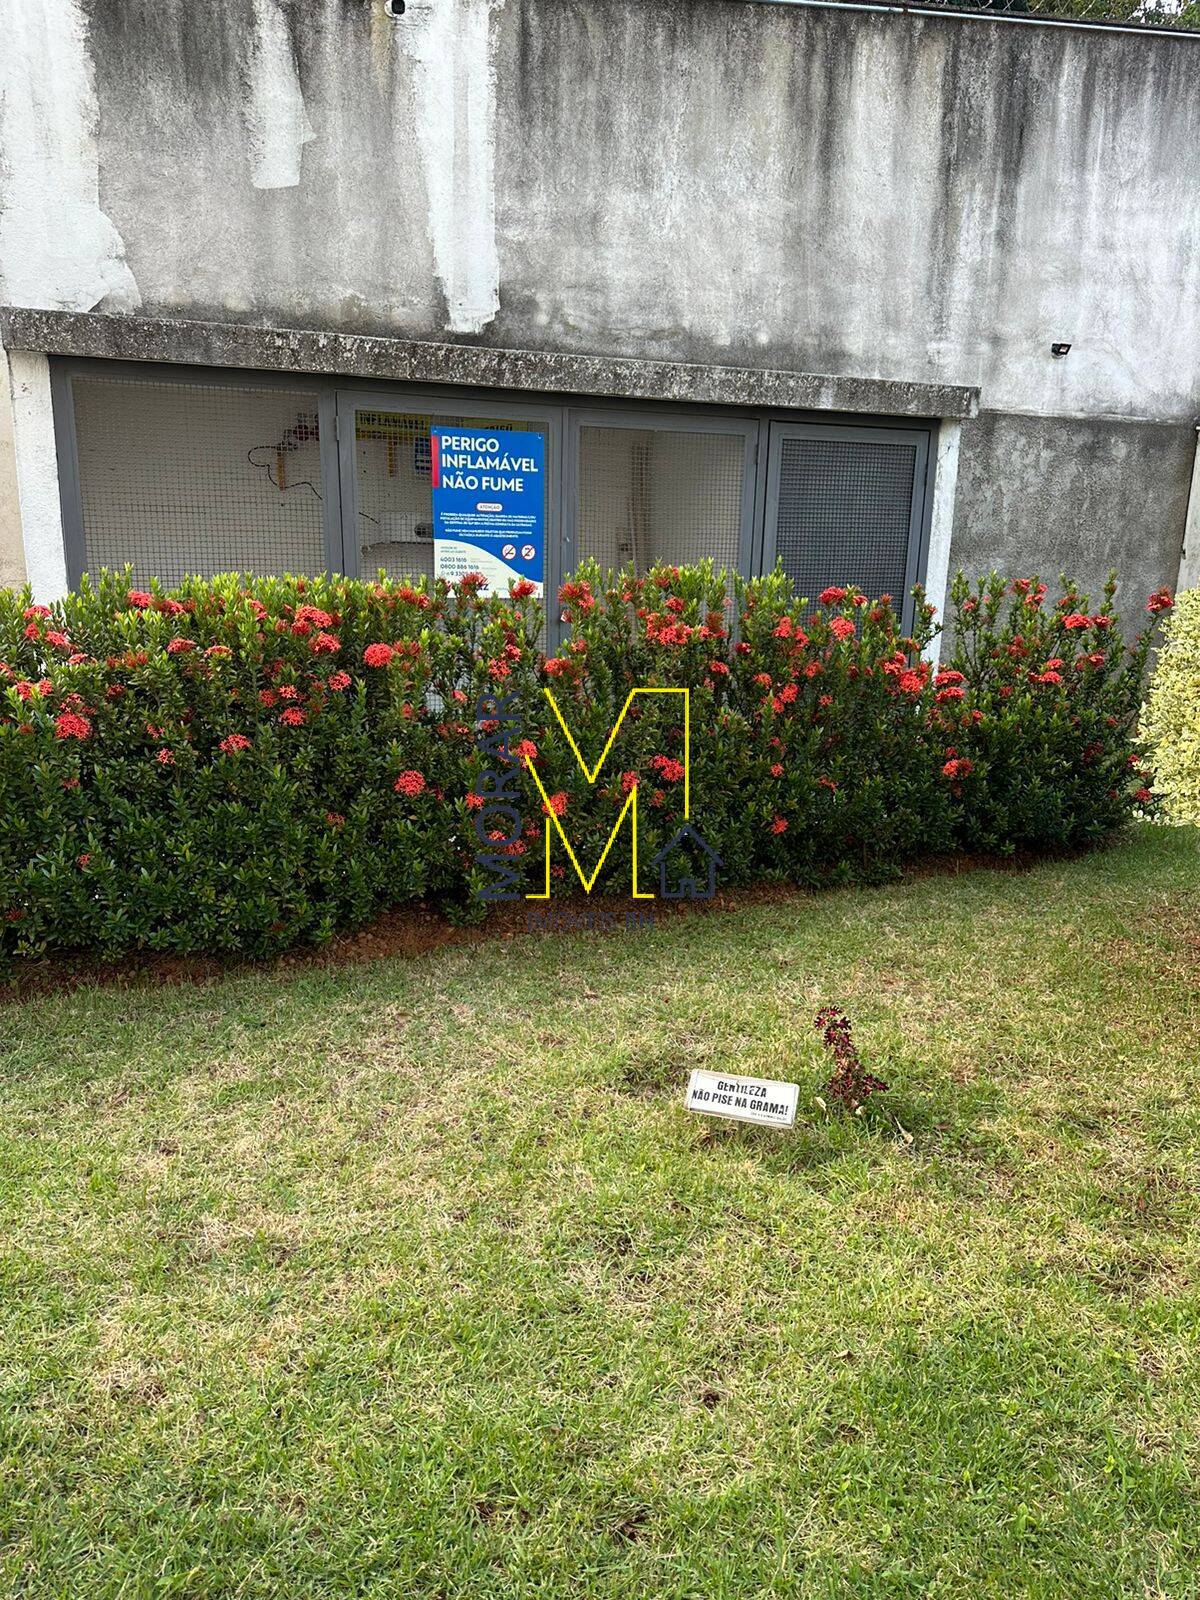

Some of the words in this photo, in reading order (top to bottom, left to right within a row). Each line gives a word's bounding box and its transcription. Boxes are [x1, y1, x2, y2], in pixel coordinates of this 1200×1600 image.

[442, 436, 499, 452] PERIGO
[442, 452, 538, 472] INFLAMÁVEL
[442, 472, 478, 490] NÃO
[482, 478, 523, 492] FUME
[717, 1080, 767, 1098] GENTILEZA
[692, 1089, 710, 1101] NÃO
[711, 1092, 733, 1106] PISE
[734, 1096, 748, 1109] NA
[750, 1099, 789, 1116] GRAMA!
